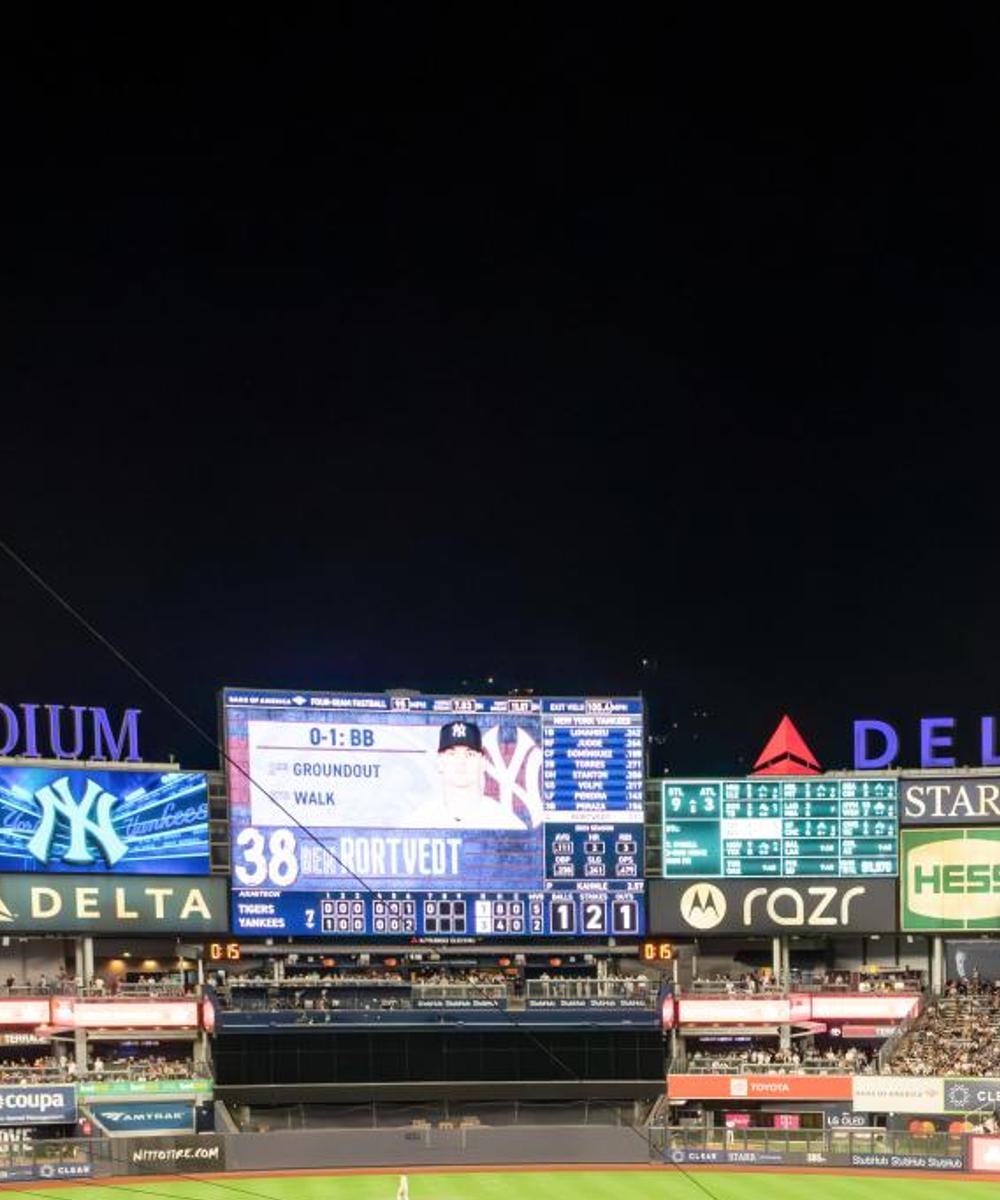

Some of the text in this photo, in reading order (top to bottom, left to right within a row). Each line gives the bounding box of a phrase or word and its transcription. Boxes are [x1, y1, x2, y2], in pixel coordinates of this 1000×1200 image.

[310, 728, 375, 747] 0-1: BB
[293, 763, 381, 778] GROUNDOUT
[294, 791, 335, 806] WALK
[235, 827, 299, 887] 38
[31, 886, 212, 919] DELTA
[743, 886, 866, 926] razr
[558, 904, 630, 929] 1 2 1
[750, 1083, 789, 1092] TOYOTA
[6, 1092, 65, 1112] coupa
[124, 1113, 182, 1121] AMTRAK
[827, 1116, 865, 1126] LG OLED
[688, 1152, 717, 1160] CLEAR
[852, 1154, 963, 1169] StubHub StubHub StubHub
